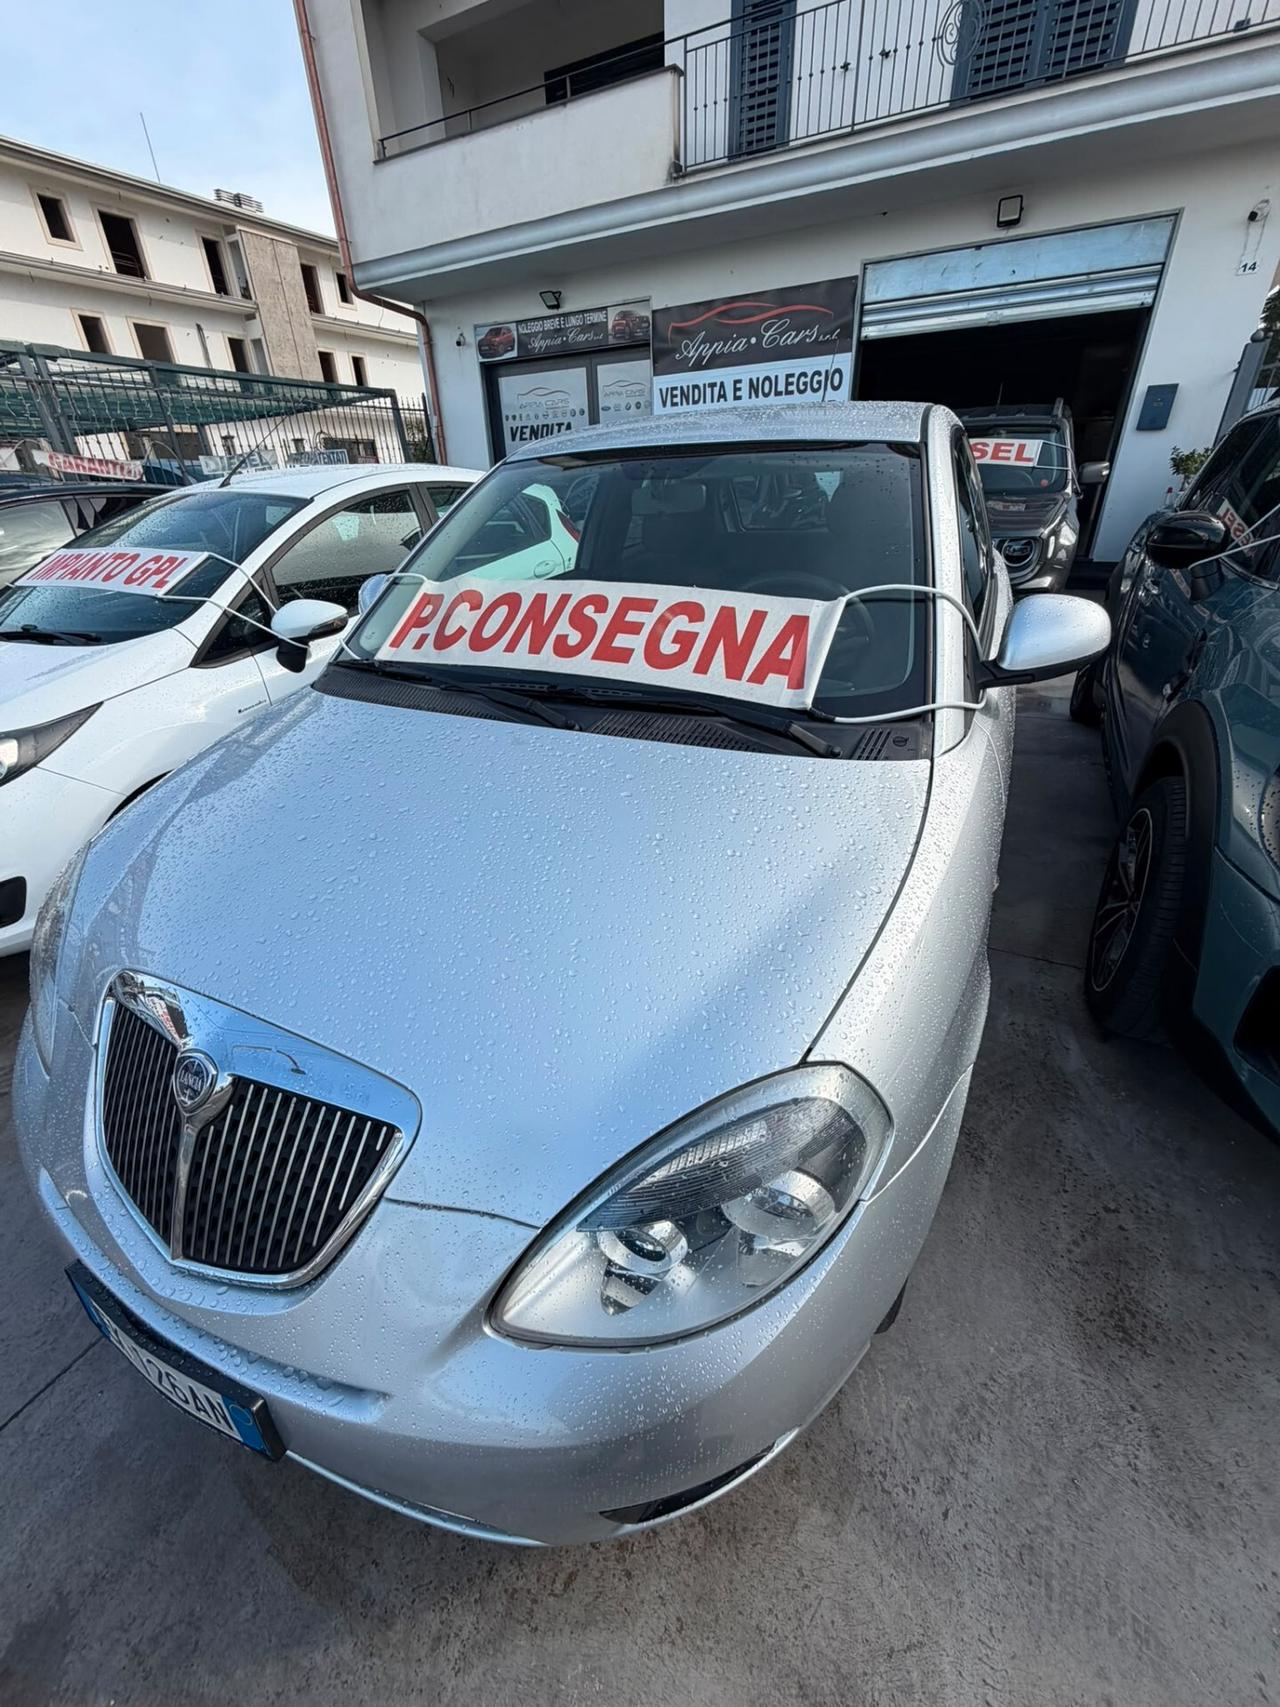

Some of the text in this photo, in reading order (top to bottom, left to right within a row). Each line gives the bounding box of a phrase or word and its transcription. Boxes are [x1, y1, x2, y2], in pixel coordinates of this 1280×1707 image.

[1241, 261, 1257, 273] 14
[518, 310, 607, 334] NOLEGGIO BREVE E LUNGO TERMINE
[528, 333, 562, 353] Appia
[566, 327, 594, 343] Cars
[675, 329, 748, 368] Appia
[761, 318, 819, 348] Cars
[659, 367, 844, 408] VENDITA E NOLEGGIO
[510, 421, 572, 442] VENDITA
[27, 552, 188, 589] IMPIANTO GPL
[388, 589, 811, 690] P.CONSEGNA
